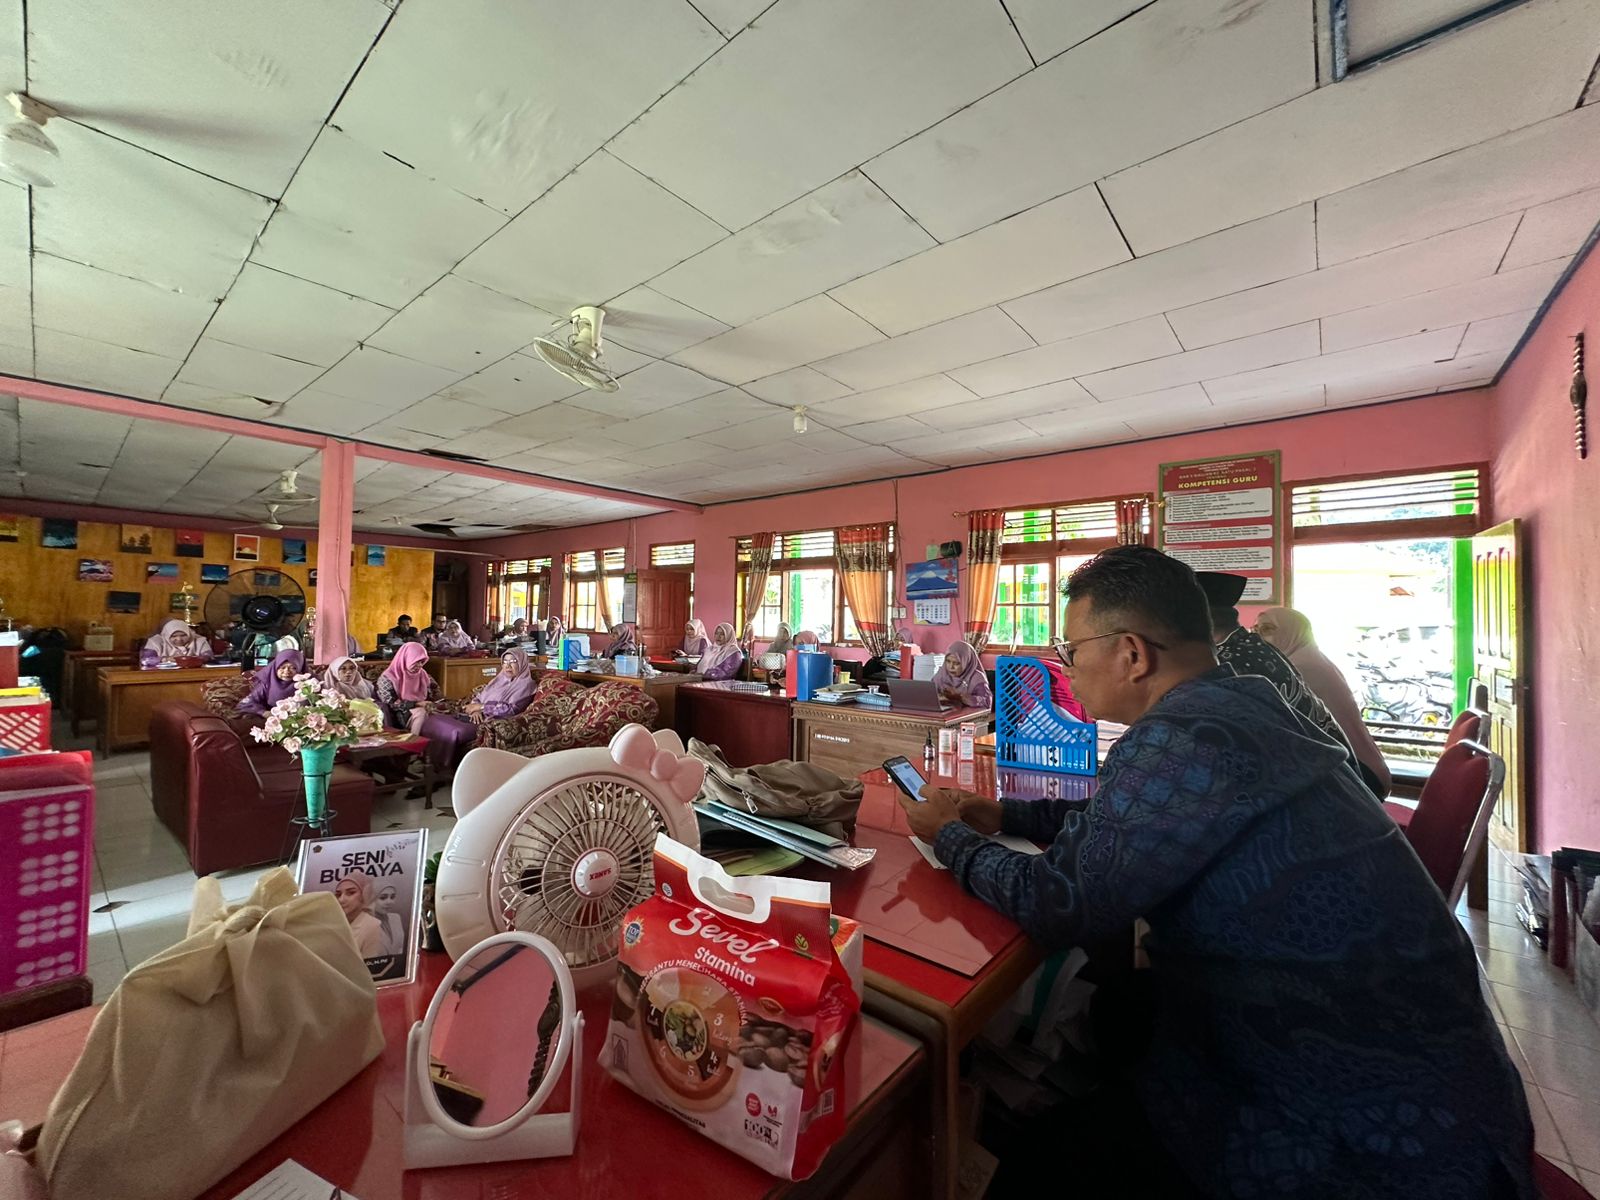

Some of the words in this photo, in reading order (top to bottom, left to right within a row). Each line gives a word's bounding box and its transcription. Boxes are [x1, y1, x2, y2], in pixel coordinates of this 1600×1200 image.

[1178, 478, 1230, 489] KOMPETENSI
[1232, 475, 1258, 484] GURU
[342, 850, 386, 867] SENI
[668, 907, 780, 963] Sevel
[694, 946, 757, 987] Stamina
[713, 1013, 724, 1026] 3
